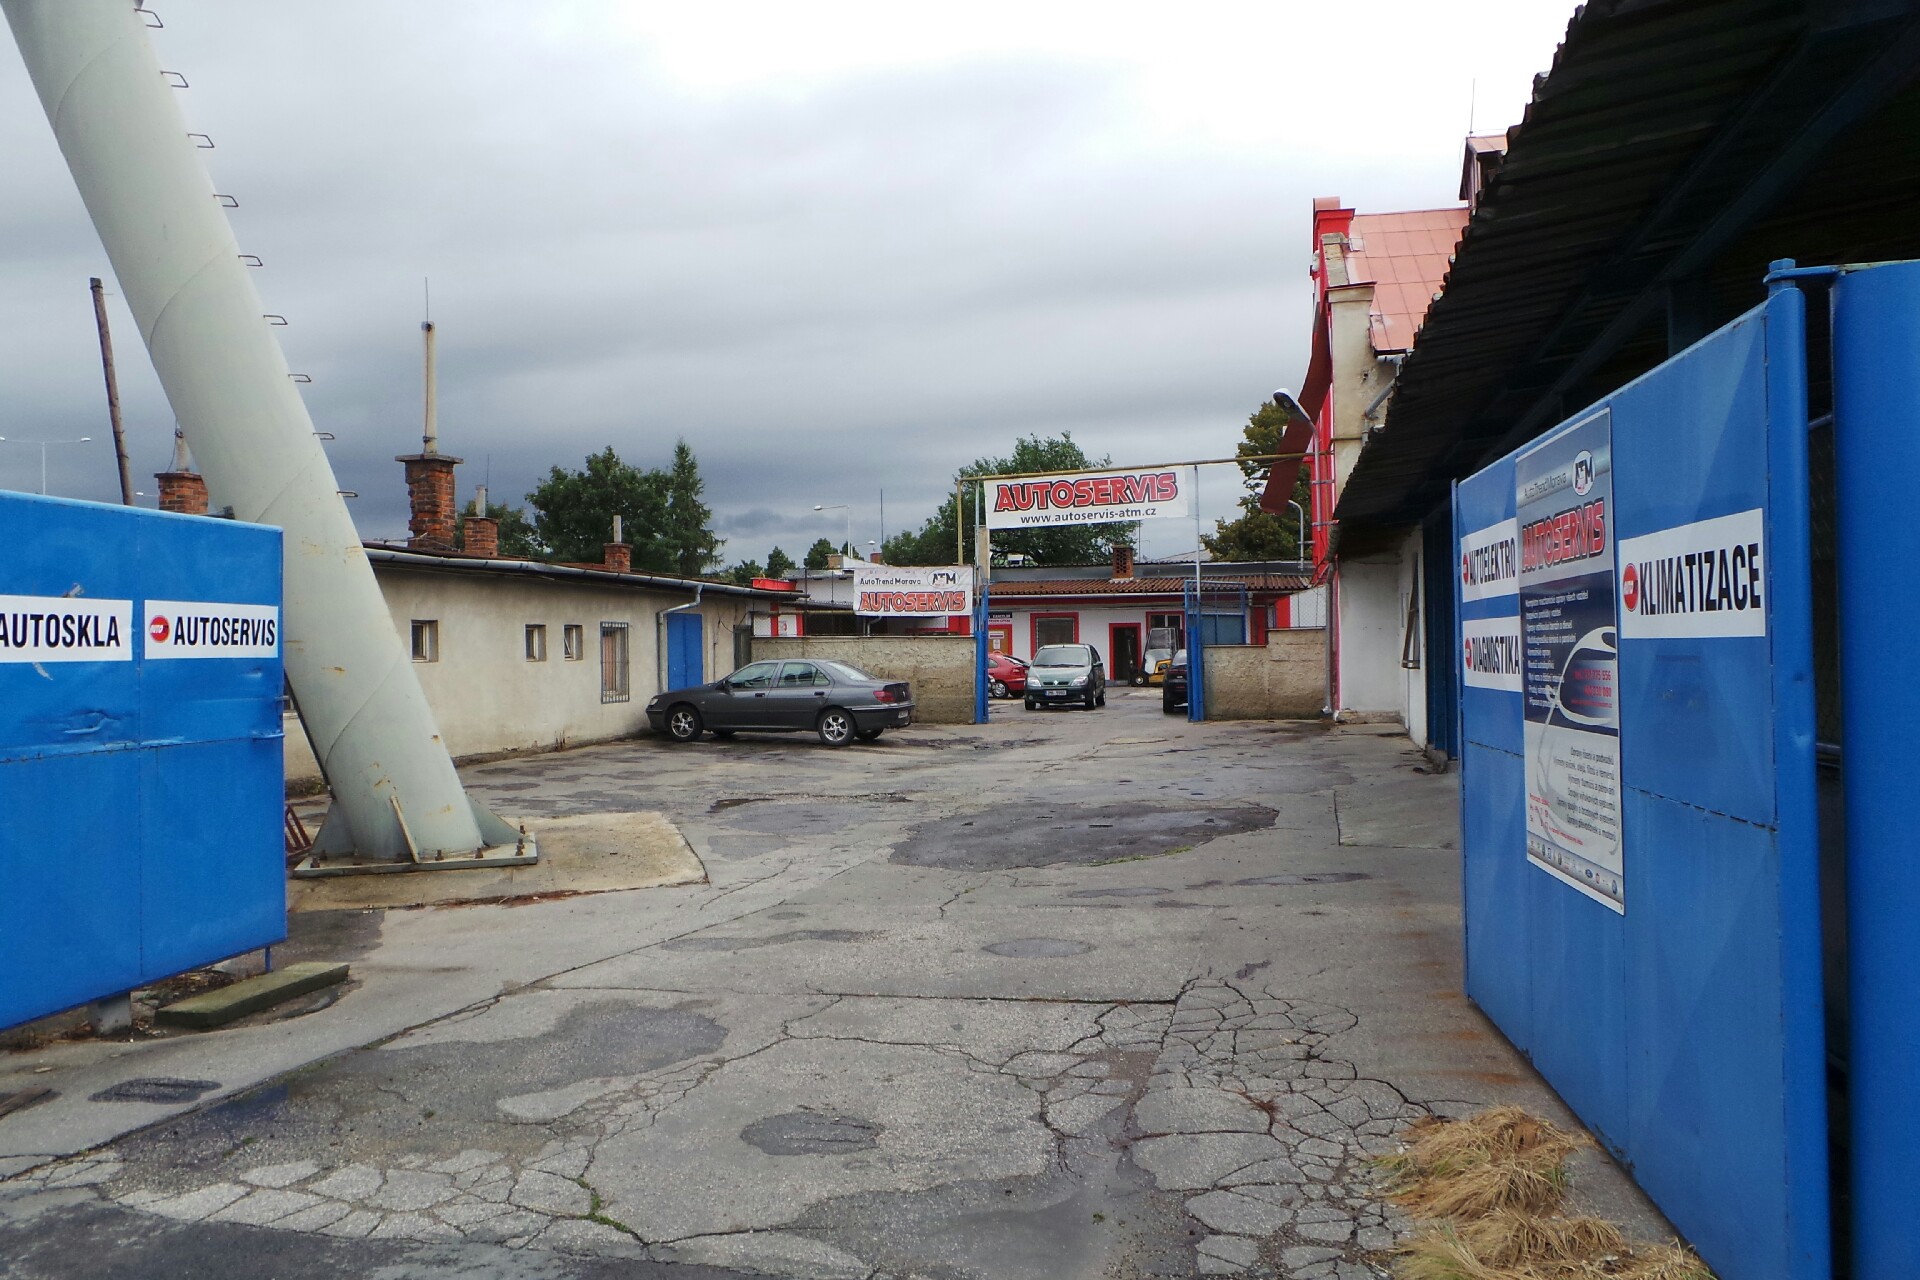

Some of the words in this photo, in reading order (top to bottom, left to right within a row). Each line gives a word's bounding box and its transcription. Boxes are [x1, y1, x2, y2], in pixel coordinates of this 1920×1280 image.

[994, 472, 1178, 512] AUTOSERVIS
[1020, 507, 1157, 524] www.autoservis-atm.cz
[1521, 498, 1606, 574] AUTOSERVIS
[1469, 537, 1516, 586] AUTOELEKTRO
[1640, 543, 1761, 616] KLIMATIZACE
[859, 591, 966, 612] AUTOSERVIS
[0, 613, 121, 648] AUTOSKLA
[173, 616, 276, 646] AUTOSERVIS
[1472, 635, 1520, 675] DIAGNOSTIKA
